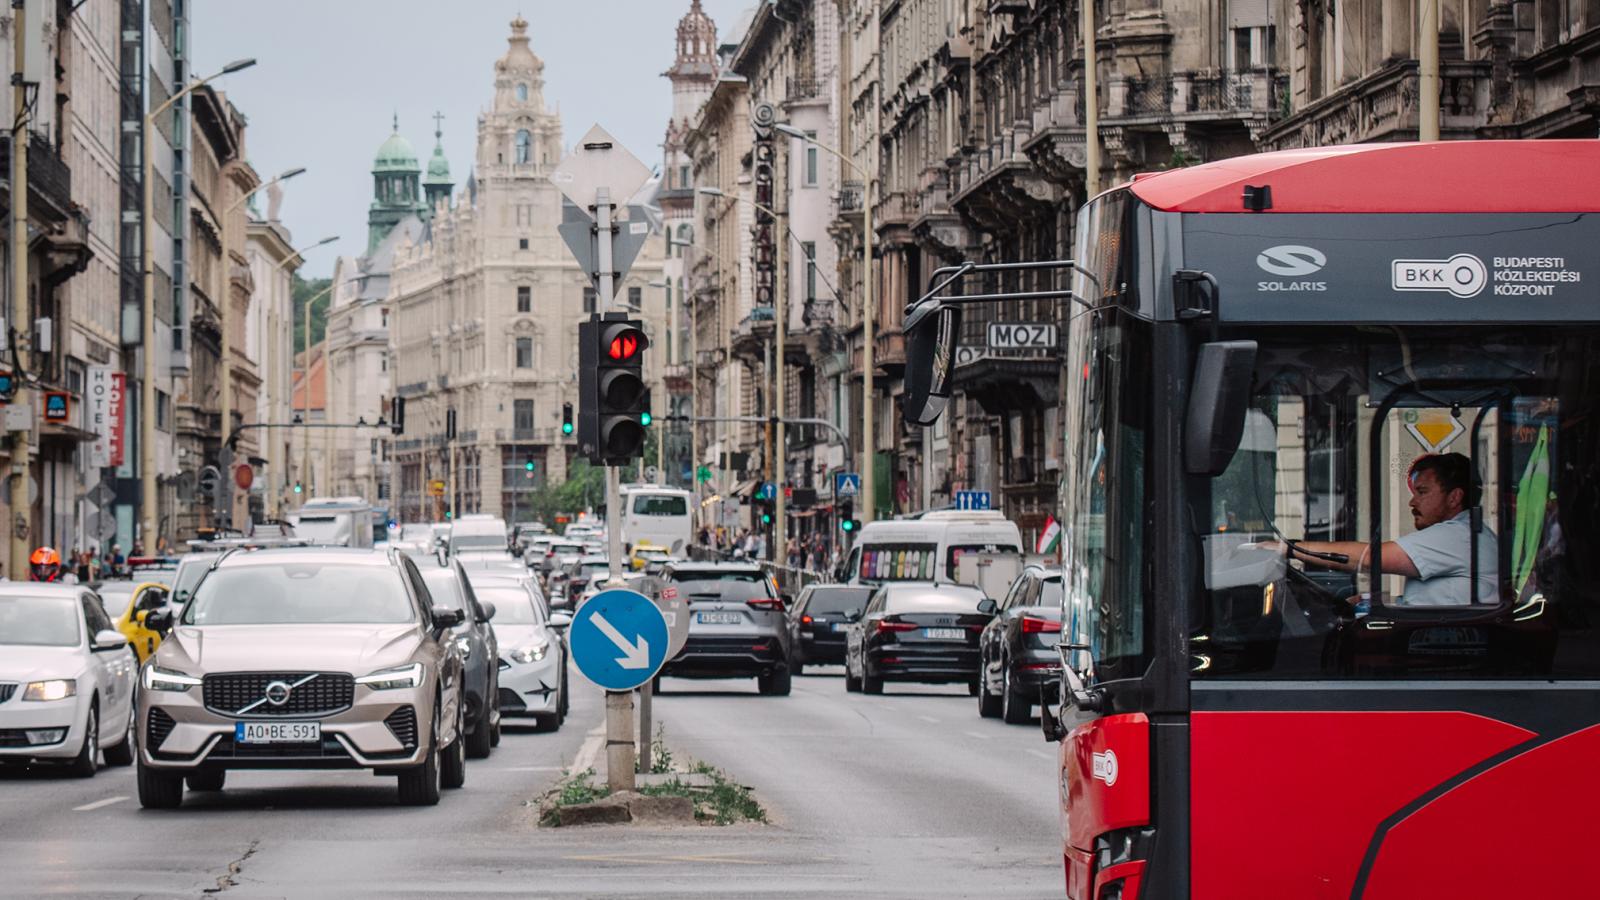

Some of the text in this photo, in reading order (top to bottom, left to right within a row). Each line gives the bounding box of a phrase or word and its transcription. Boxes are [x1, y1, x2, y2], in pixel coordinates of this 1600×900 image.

[1493, 257, 1565, 268] BUDAPESTI
[1405, 268, 1444, 282] BKK
[1493, 270, 1581, 282] KÖZLEKEDÉSI
[1257, 282, 1327, 292] SOLARIS
[1493, 284, 1555, 296] KÖZPONT
[995, 326, 1051, 345] MOZI
